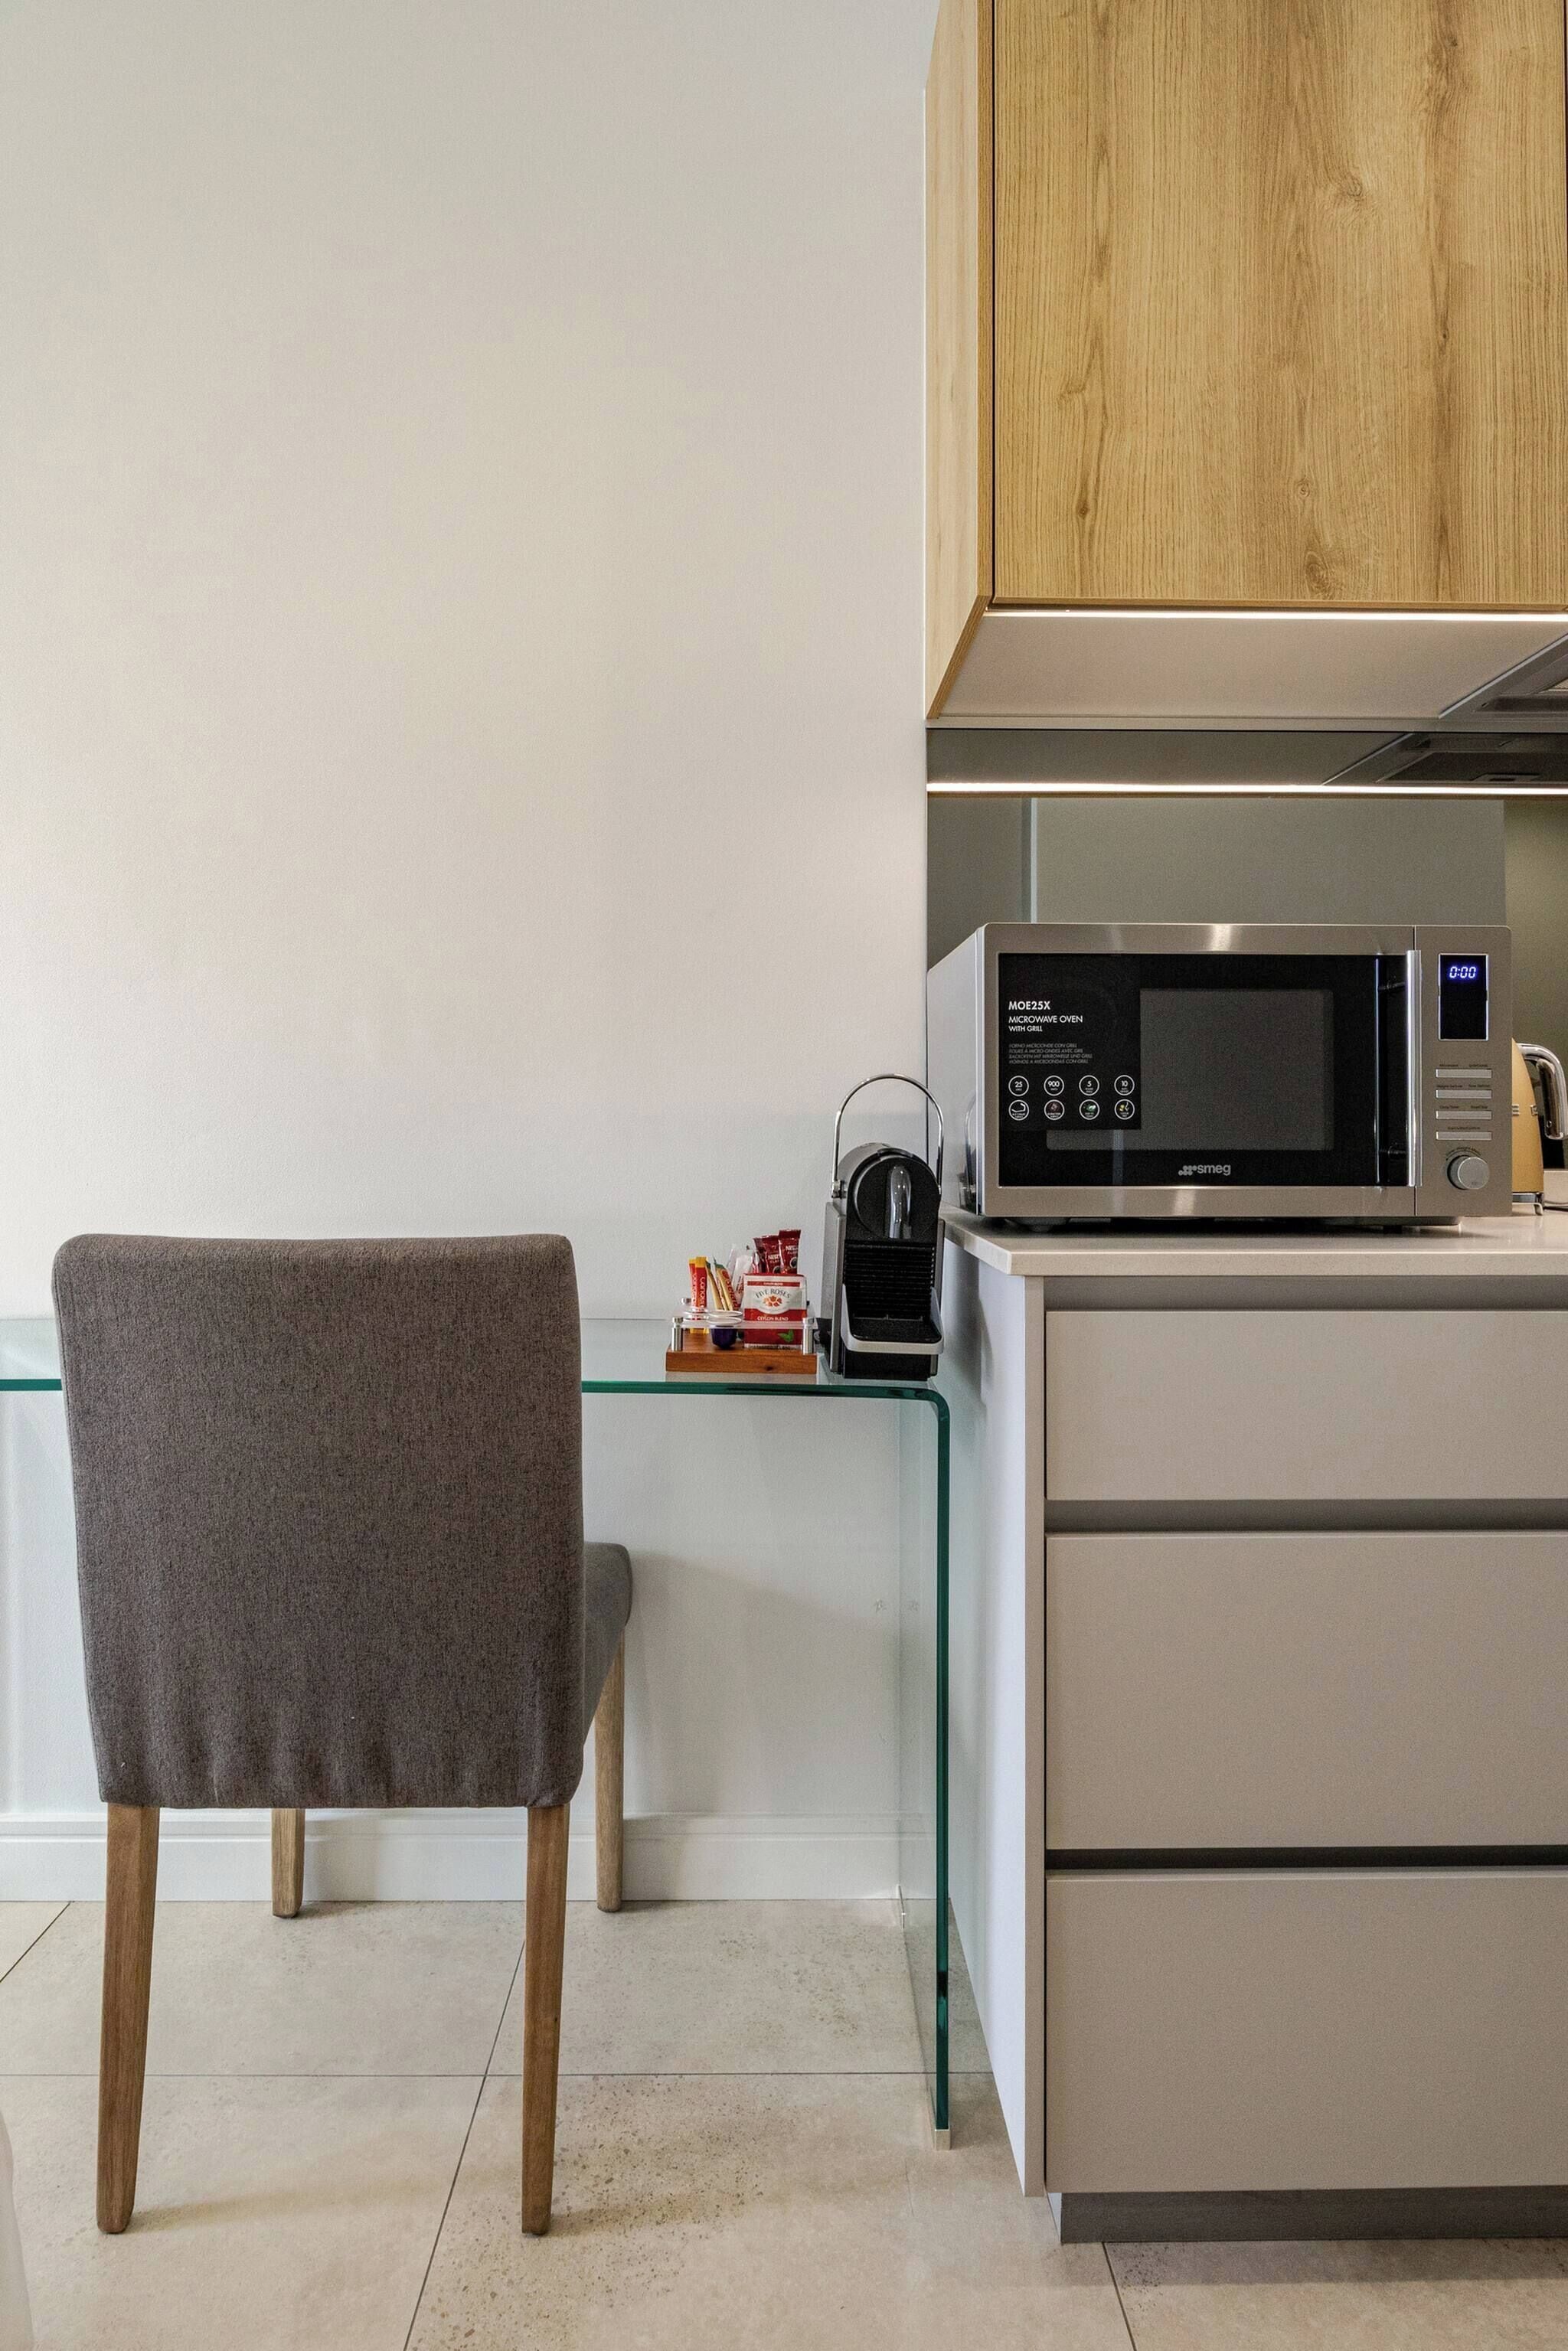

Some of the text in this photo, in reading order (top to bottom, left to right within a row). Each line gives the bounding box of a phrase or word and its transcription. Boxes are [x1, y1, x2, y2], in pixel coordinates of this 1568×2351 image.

[1449, 966, 1476, 978] 0:00
[1008, 1001, 1051, 1011] MOE25X
[1197, 1164, 1231, 1176] smeg
[756, 1288, 791, 1298] FIVE ROSES
